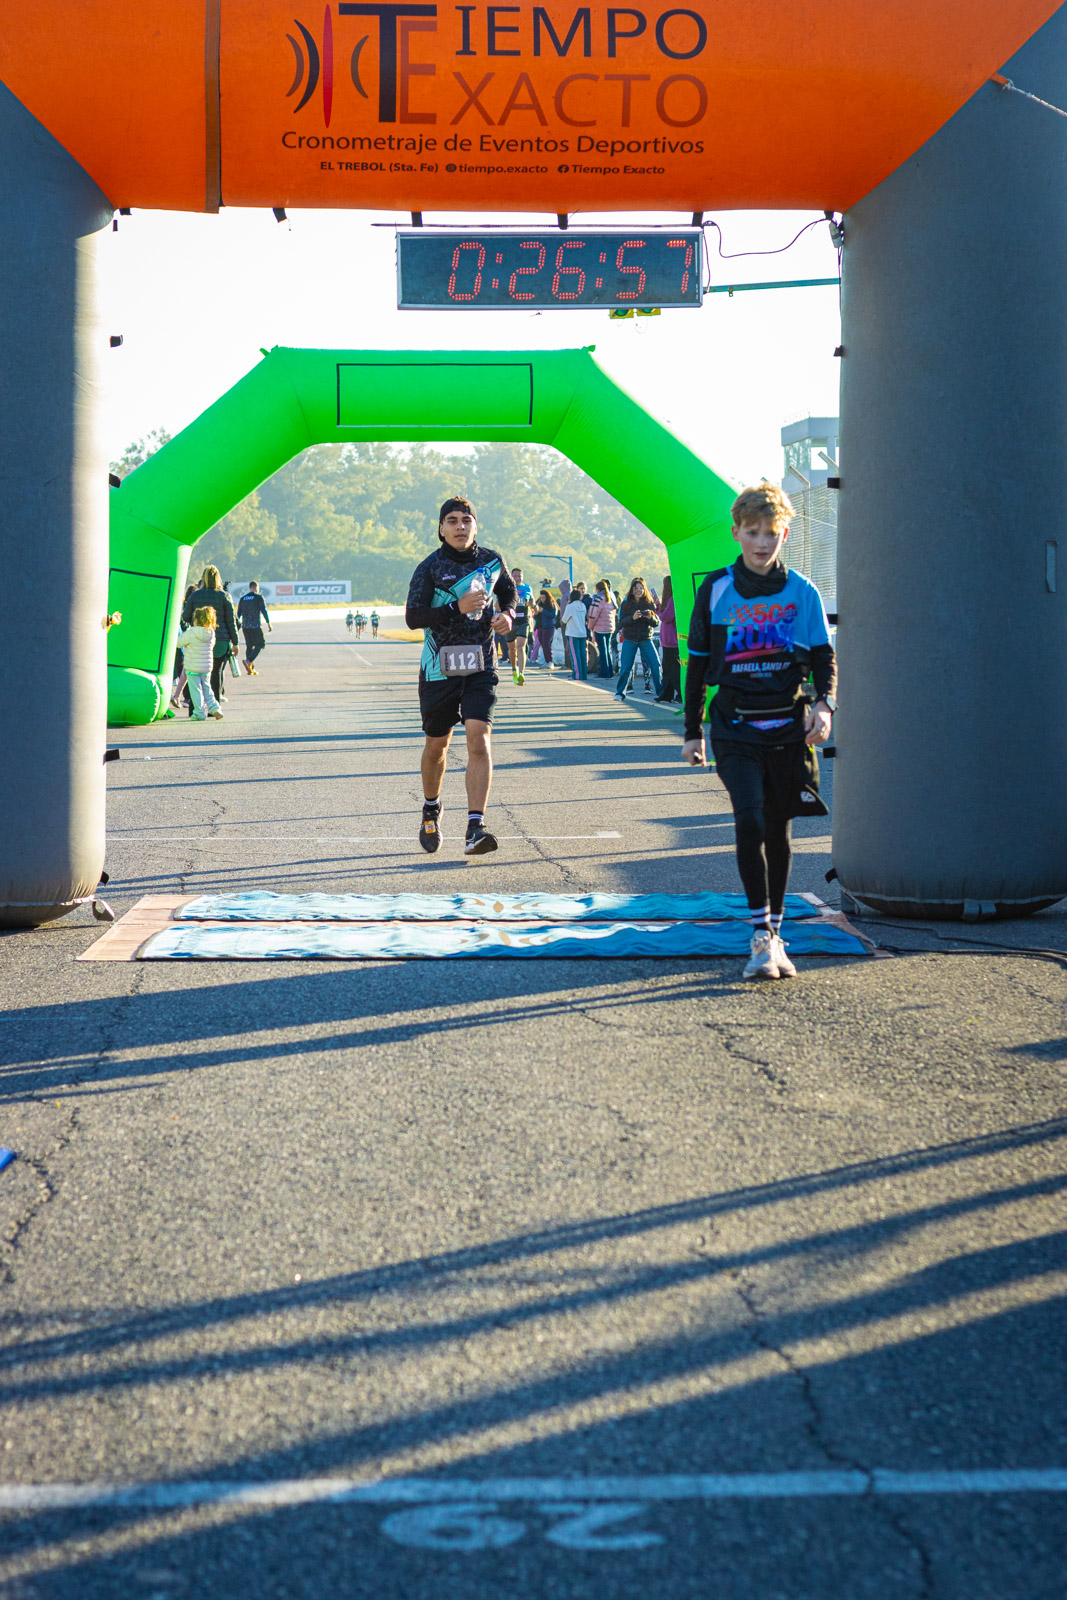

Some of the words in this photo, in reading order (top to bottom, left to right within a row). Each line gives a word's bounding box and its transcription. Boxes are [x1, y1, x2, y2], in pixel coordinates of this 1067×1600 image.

[281, 131, 437, 155] Cronometraje
[443, 133, 472, 152] de
[479, 134, 569, 153] Eventos
[577, 135, 705, 157] Deportivos
[320, 161, 335, 171] EL
[337, 161, 386, 172] TREBOL
[389, 161, 418, 173] (Sta.
[420, 162, 439, 173] Fe)
[458, 163, 548, 175] tiempo.exacto
[572, 164, 620, 175] Tiempo
[623, 165, 665, 174] Exacto
[448, 240, 693, 300] 0:26:57
[297, 585, 343, 594] LONG
[725, 624, 793, 652] RUN
[449, 652, 476, 670] 112
